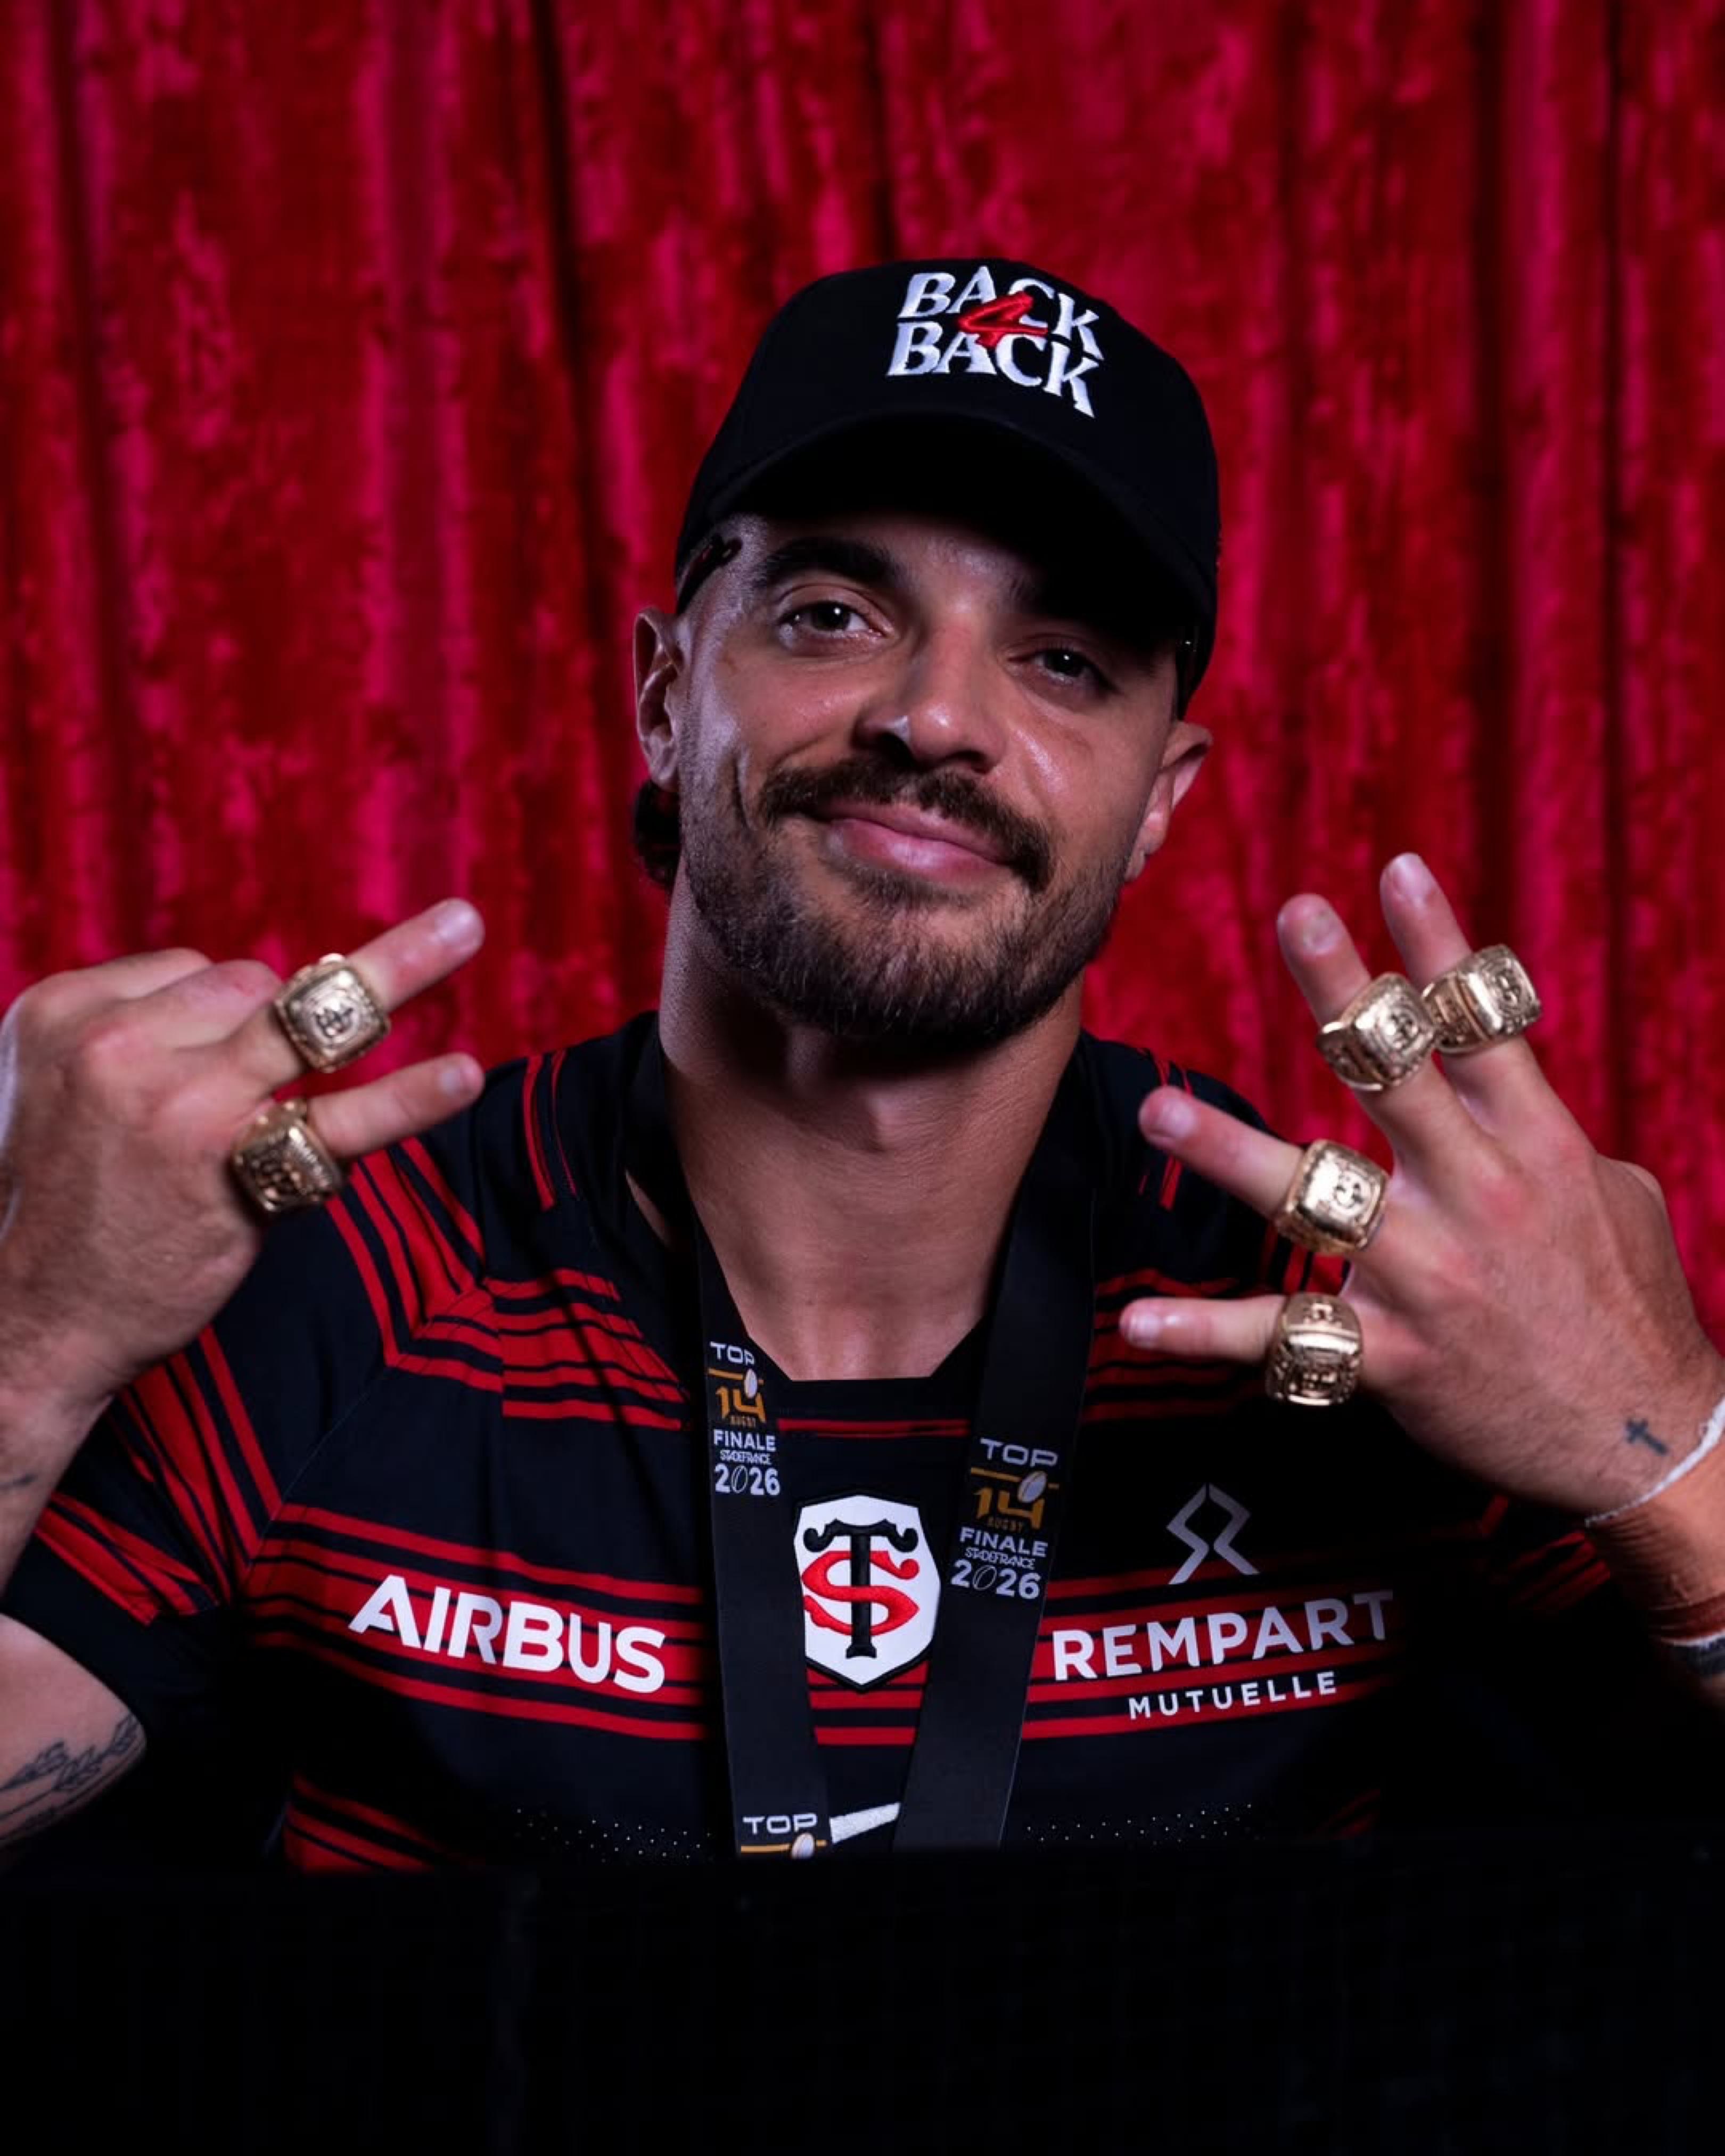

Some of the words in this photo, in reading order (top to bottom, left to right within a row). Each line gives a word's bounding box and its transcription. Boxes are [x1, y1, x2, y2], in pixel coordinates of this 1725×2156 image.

[897, 266, 1104, 360] BACK
[958, 291, 1048, 348] 4
[886, 321, 1099, 418] BACK
[710, 1341, 754, 1366] TOP
[716, 1386, 766, 1423] 14
[713, 1429, 776, 1452] FINALE
[980, 1437, 1058, 1467] TOP
[714, 1463, 781, 1496] 2026
[974, 1488, 1045, 1529] 14
[959, 1526, 1048, 1558] FINALE
[951, 1559, 1040, 1599] 2026
[348, 1574, 666, 1693] AIRBUS
[1052, 1590, 1393, 1681] REMPART
[1128, 1671, 1337, 1719] MUTUELLE
[743, 1813, 817, 1834] TOP
